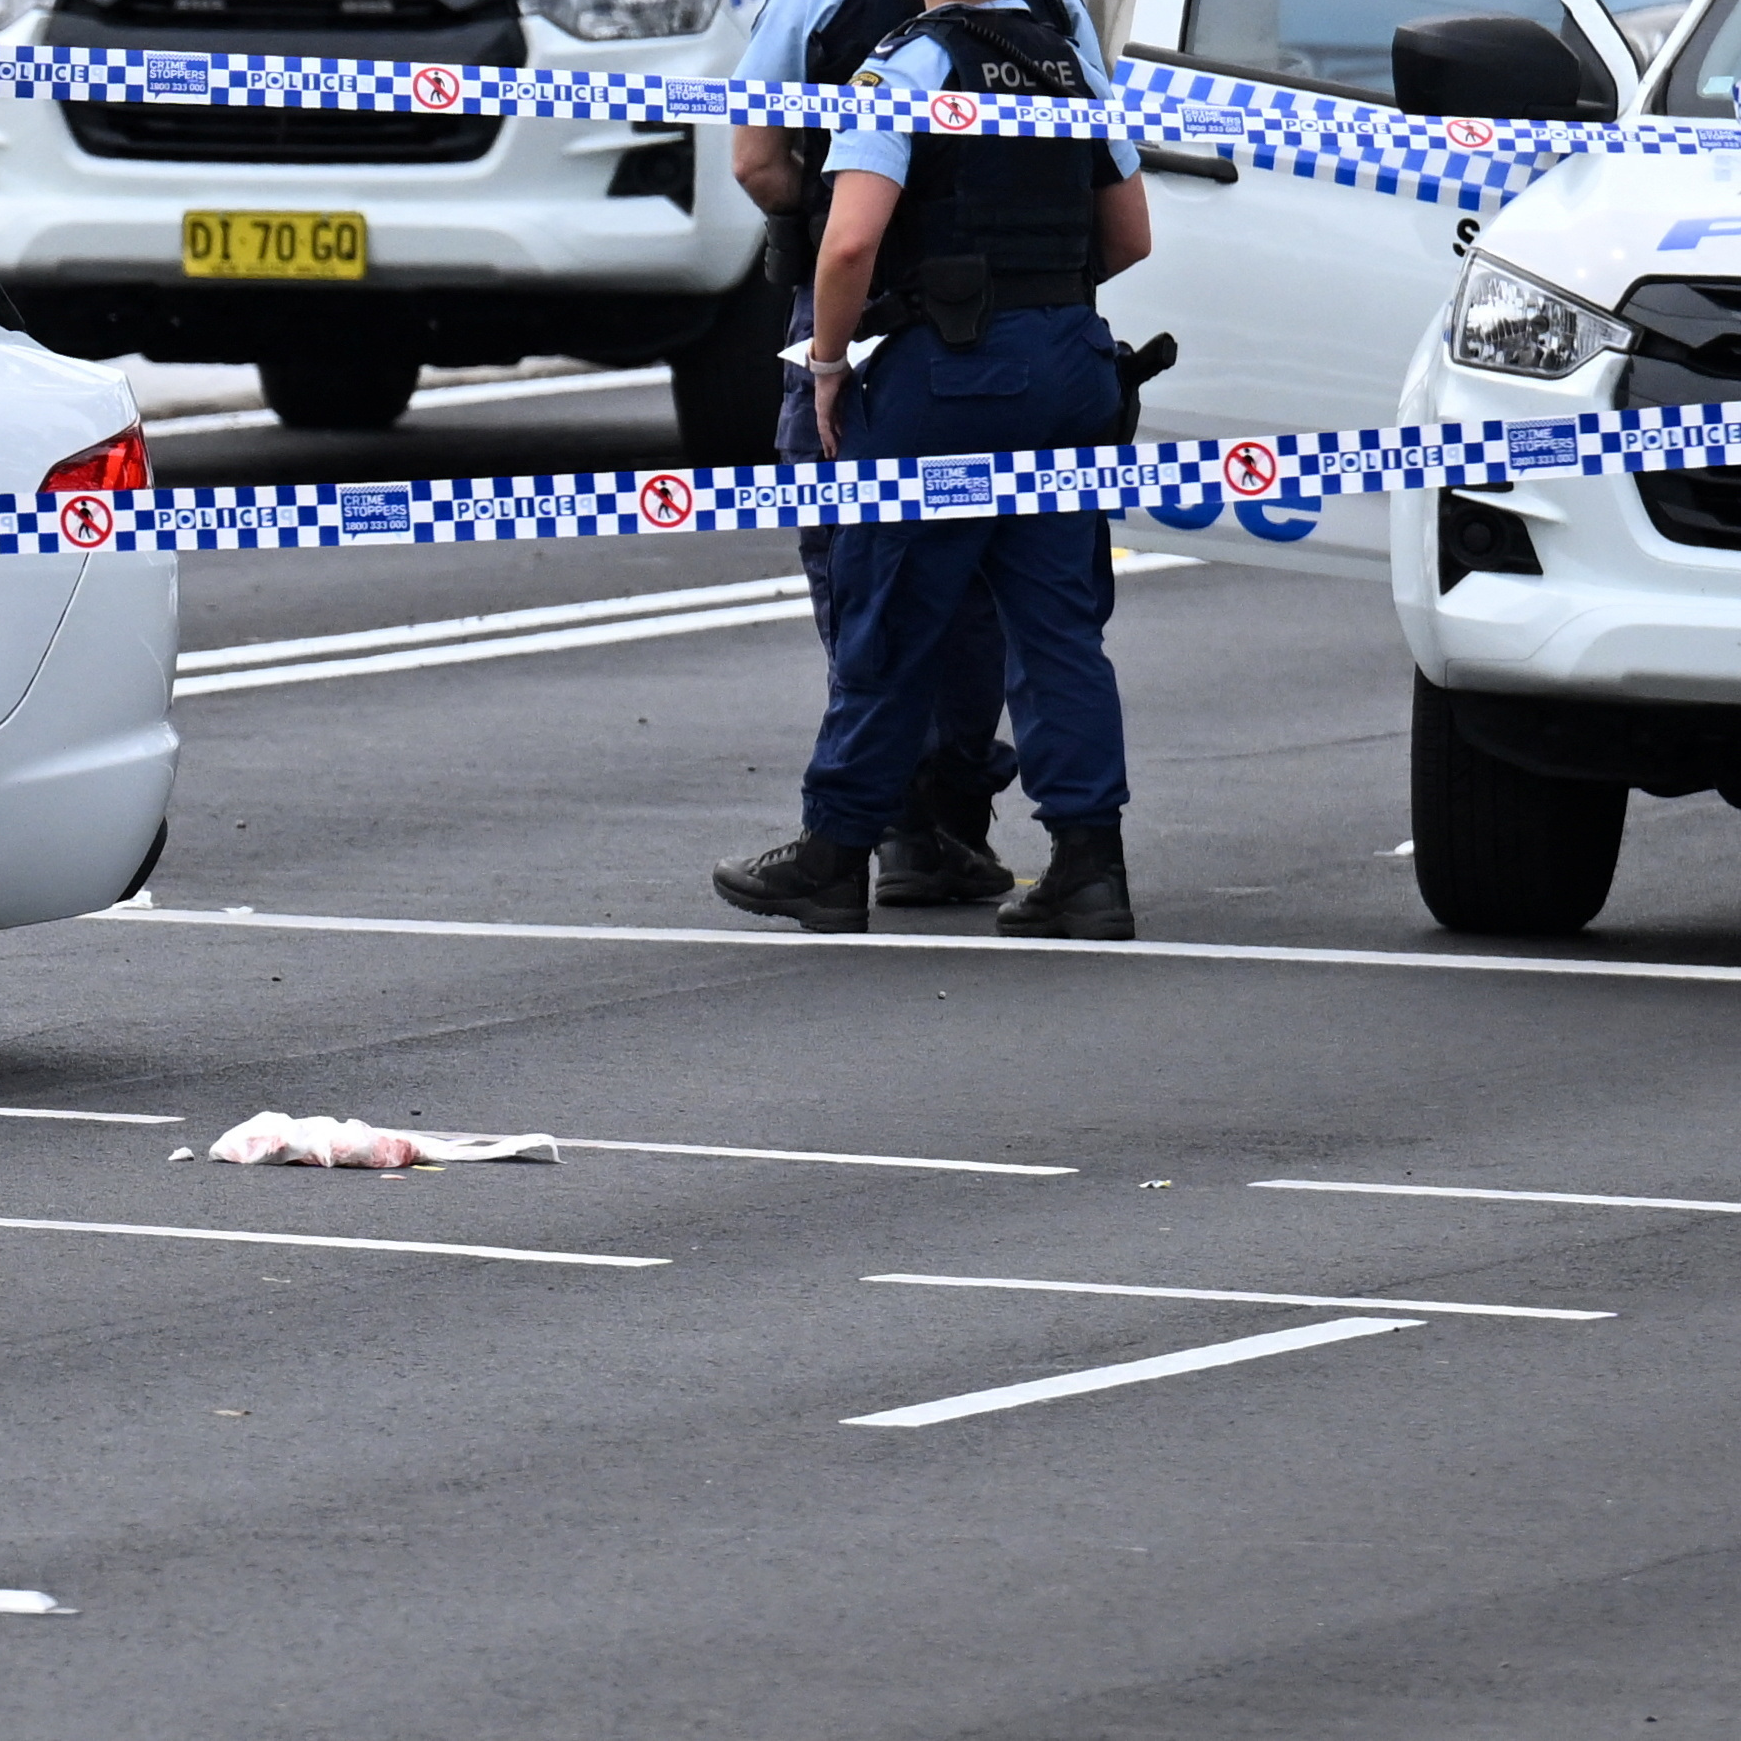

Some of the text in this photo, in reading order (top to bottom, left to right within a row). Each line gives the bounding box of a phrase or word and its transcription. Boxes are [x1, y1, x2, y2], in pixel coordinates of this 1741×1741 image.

[149, 60, 186, 70] CRIME
[149, 69, 205, 79] STOPPERS
[982, 60, 1076, 88] POLCE
[250, 72, 355, 92] POLICE
[668, 84, 705, 93] CRIME
[502, 83, 607, 103] POLICE
[668, 92, 724, 101] STOPPERS
[768, 95, 874, 113] POLICE
[1019, 107, 1123, 124] POLICE
[1285, 119, 1390, 134] POLICE
[1535, 129, 1640, 141] POLICE
[1509, 428, 1553, 441] CRIME
[1625, 423, 1741, 449] POLICE
[1511, 438, 1575, 452] STOPPERS
[1323, 446, 1440, 472] POLICE
[924, 467, 967, 479] CRIME
[1040, 465, 1157, 489] POLICE
[925, 477, 989, 491] STOPPERS
[344, 494, 385, 506] CRIME
[739, 483, 855, 507] POLICE
[344, 505, 407, 517] STOPPERS
[457, 497, 573, 520] POLICE
[159, 508, 274, 528] POLICE
